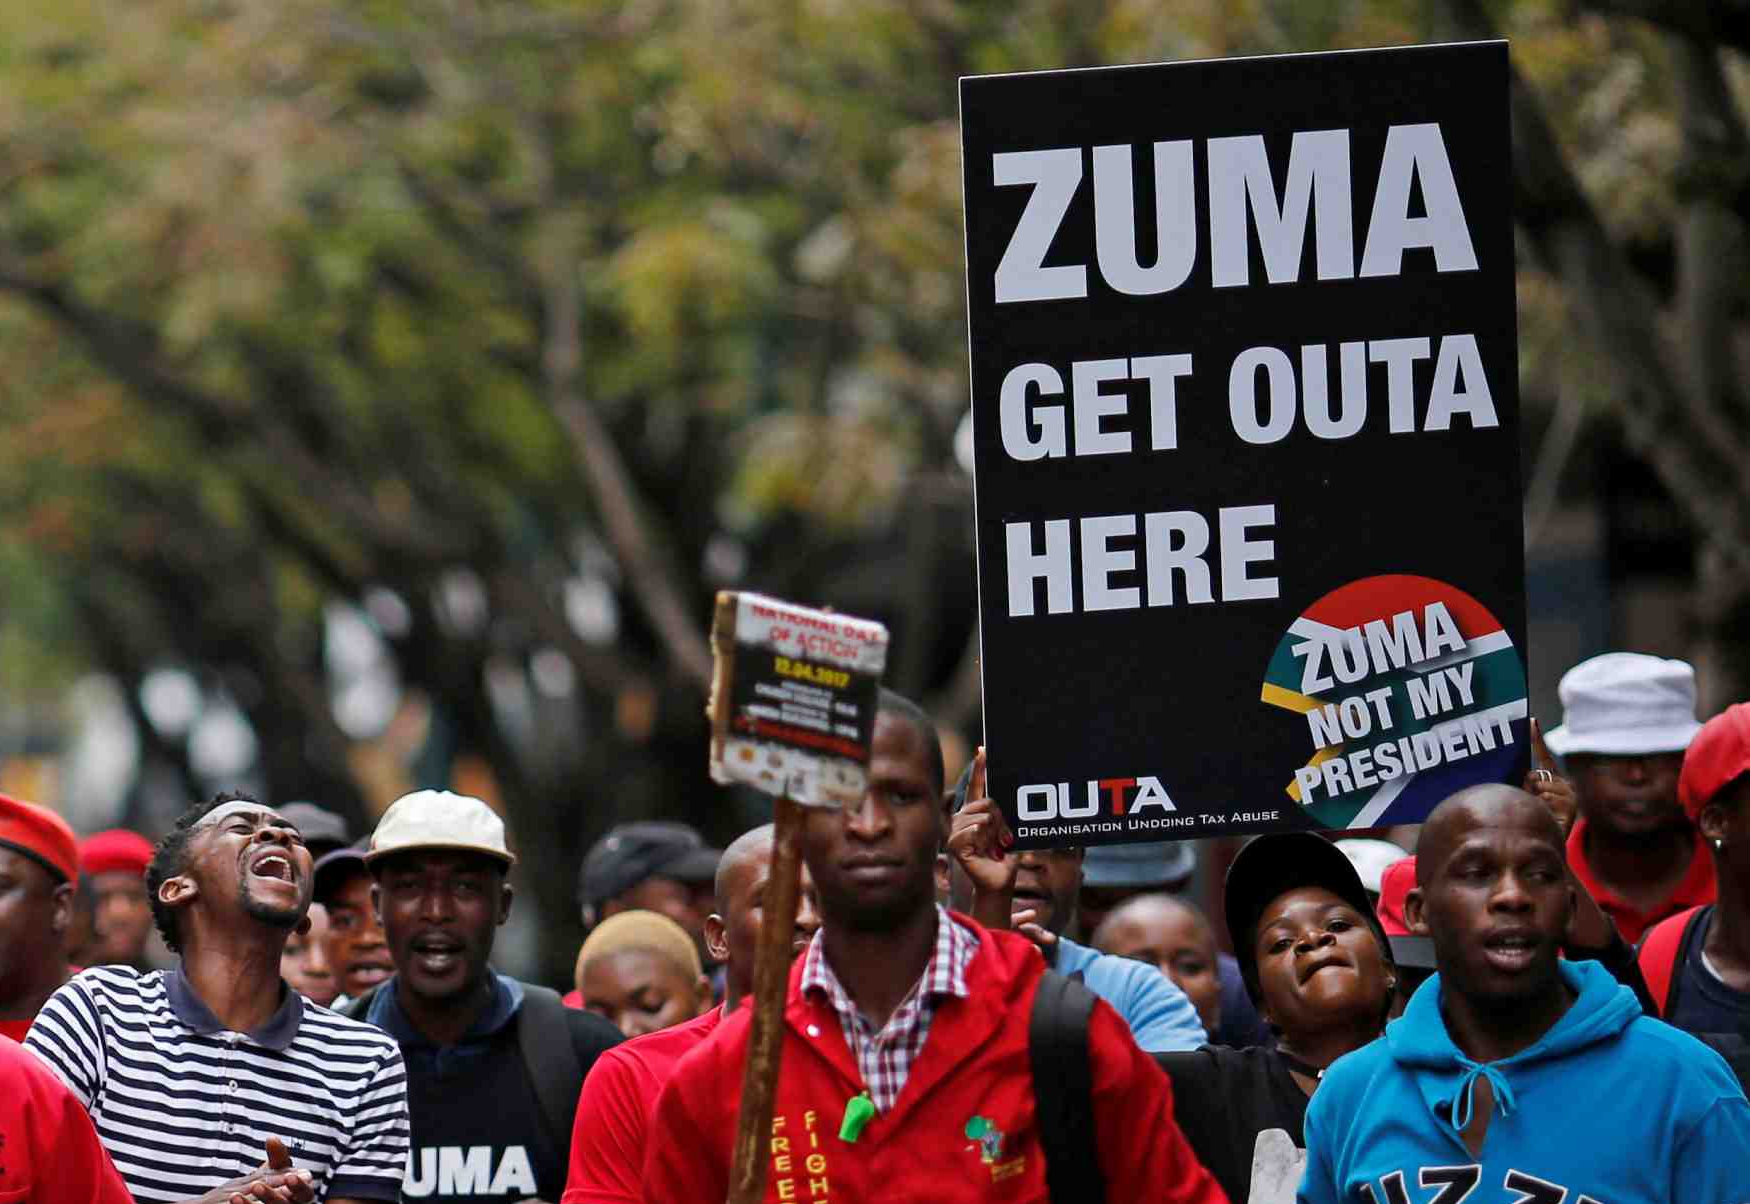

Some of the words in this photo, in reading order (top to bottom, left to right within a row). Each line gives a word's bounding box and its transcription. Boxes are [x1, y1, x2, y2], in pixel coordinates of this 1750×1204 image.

[992, 122, 1480, 304] ZUMA
[999, 353, 1193, 461] GET
[1228, 333, 1501, 445] OUTA
[1005, 503, 1280, 617] HERE
[751, 604, 838, 634] NATIONAL
[796, 634, 859, 660] ACTION
[1291, 600, 1467, 696] ZUMA
[1305, 685, 1394, 750] NOT
[1405, 661, 1475, 721] MY
[1016, 775, 1178, 822] OUTA
[1294, 709, 1515, 806] PRESIDENT
[402, 1145, 538, 1198] UMA
